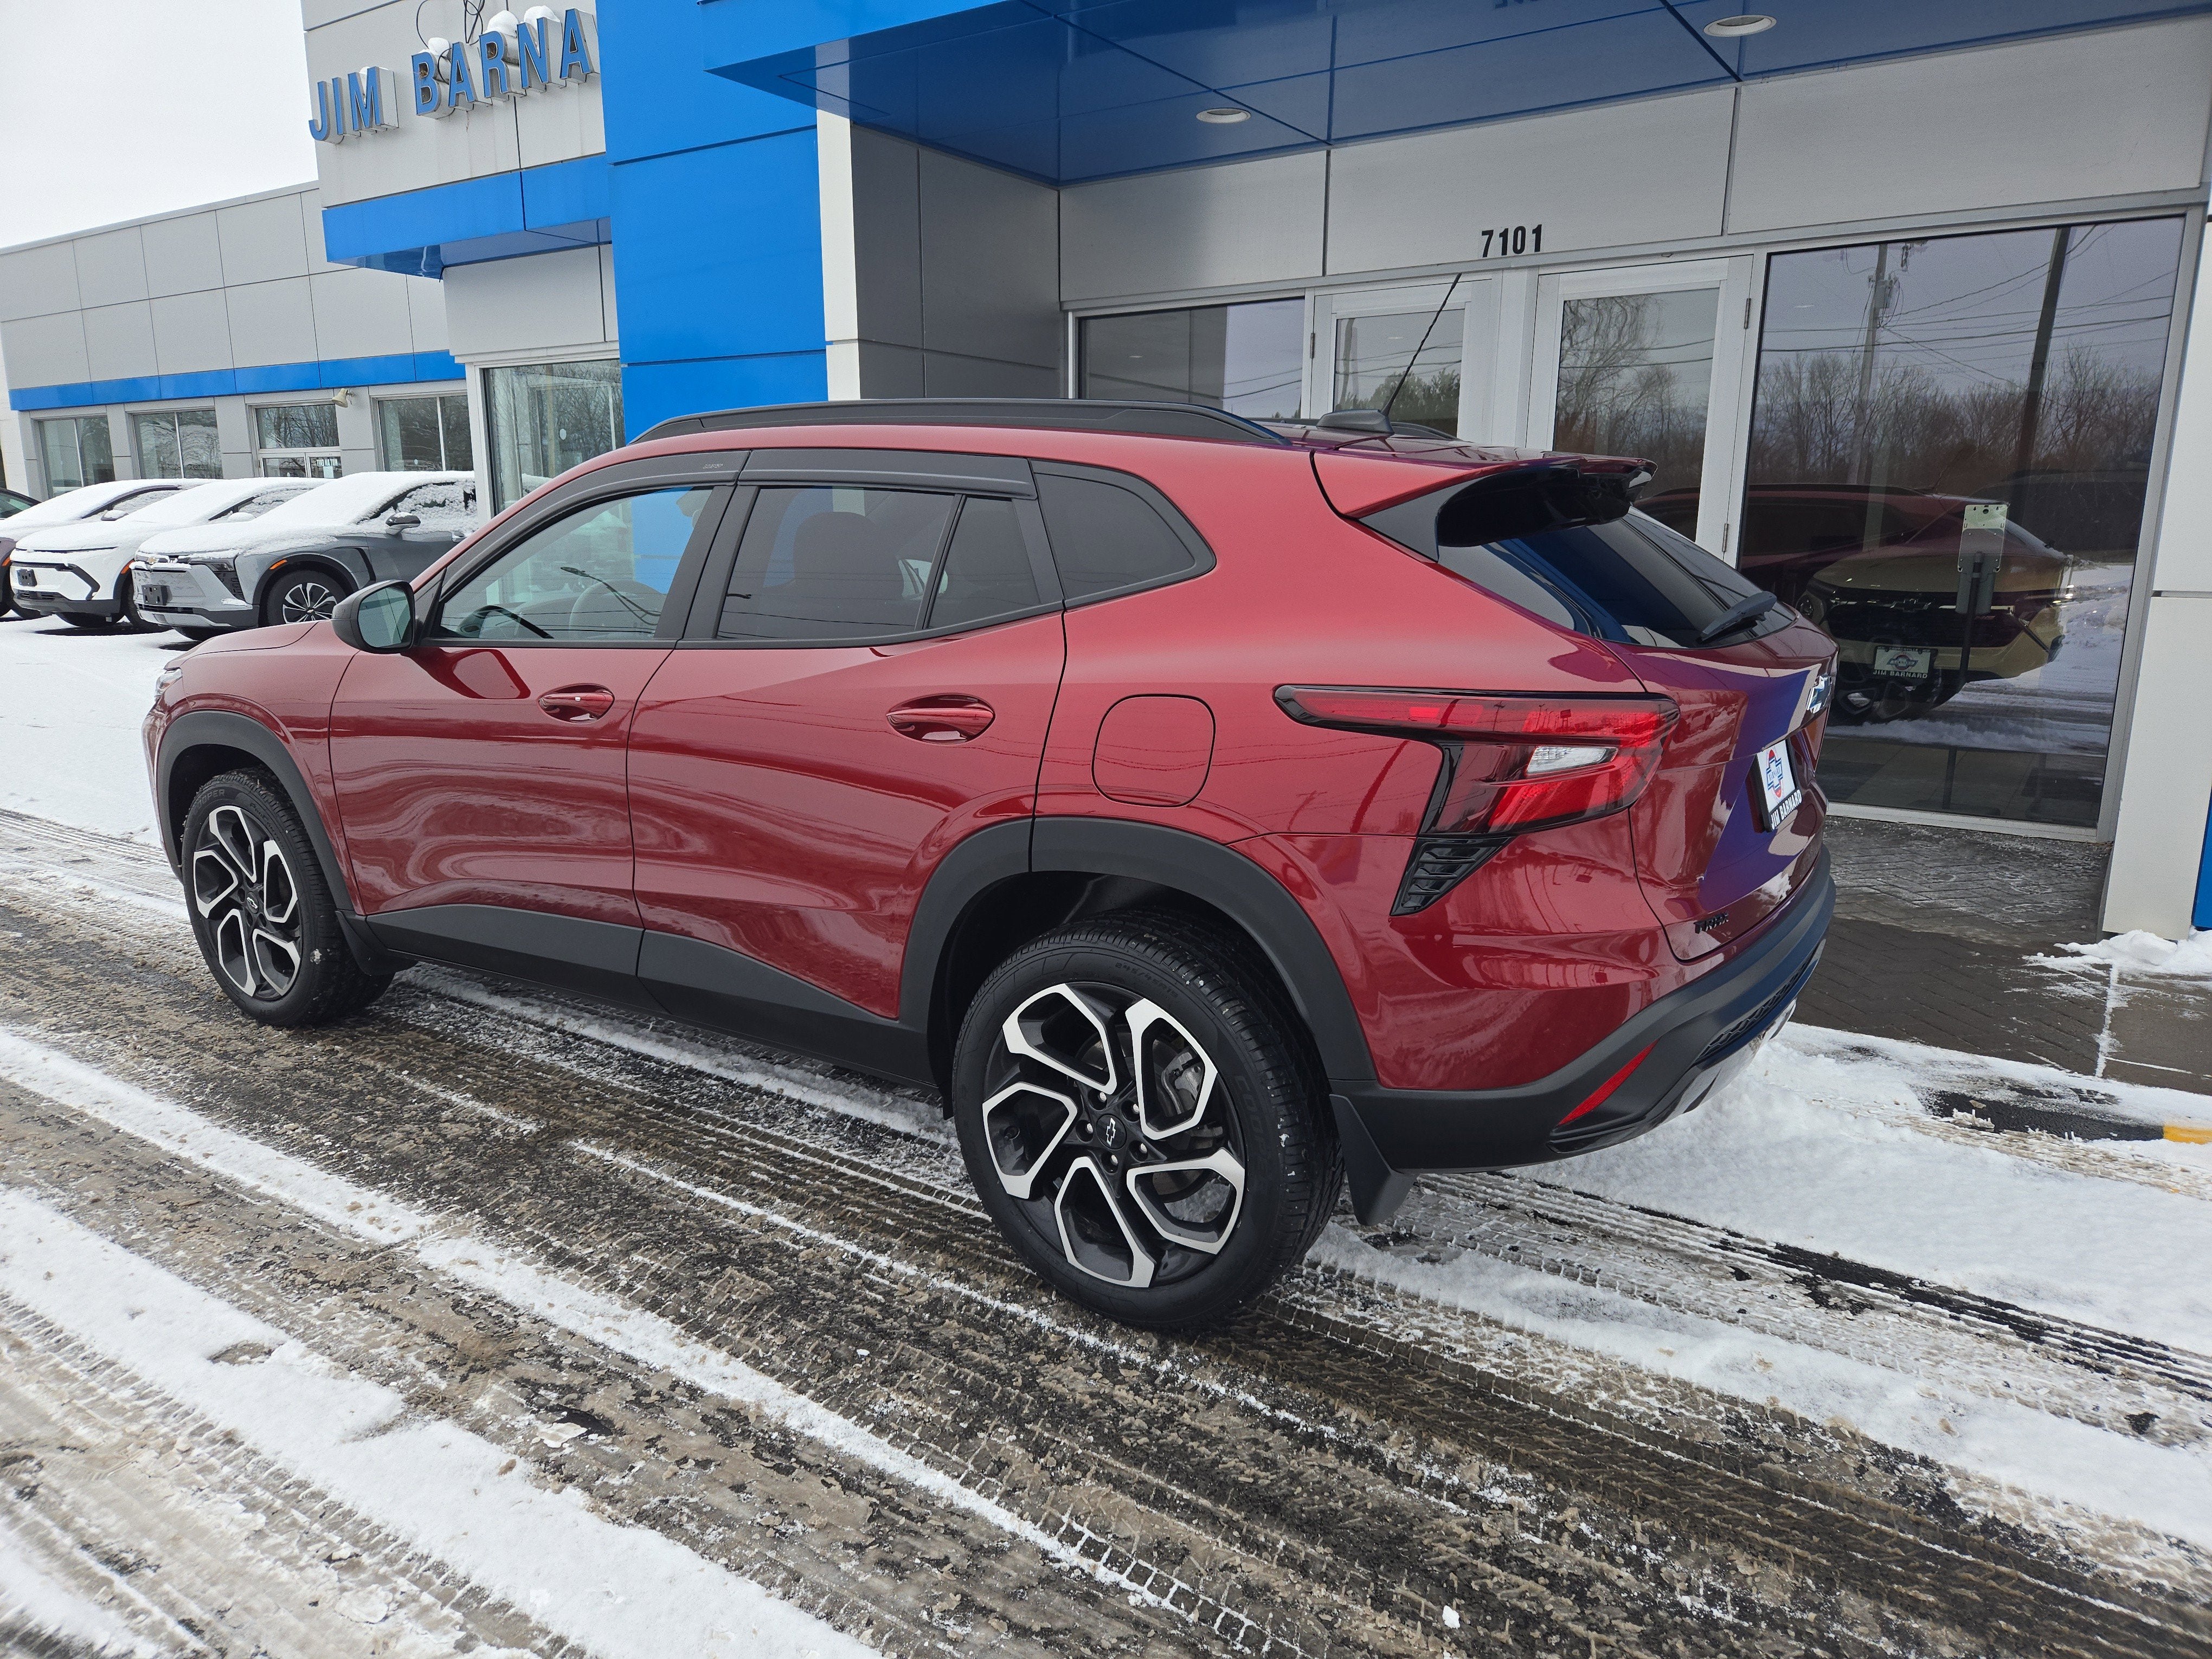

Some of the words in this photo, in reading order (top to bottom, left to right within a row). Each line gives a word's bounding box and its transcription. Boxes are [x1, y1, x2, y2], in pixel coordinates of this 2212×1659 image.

[308, 66, 382, 142] JIM
[411, 8, 592, 116] BARNA
[1481, 224, 1542, 258] 7101
[1889, 671, 1928, 679] BARNARD
[1771, 809, 1781, 830] JIM
[1779, 789, 1803, 820] BARNARD
